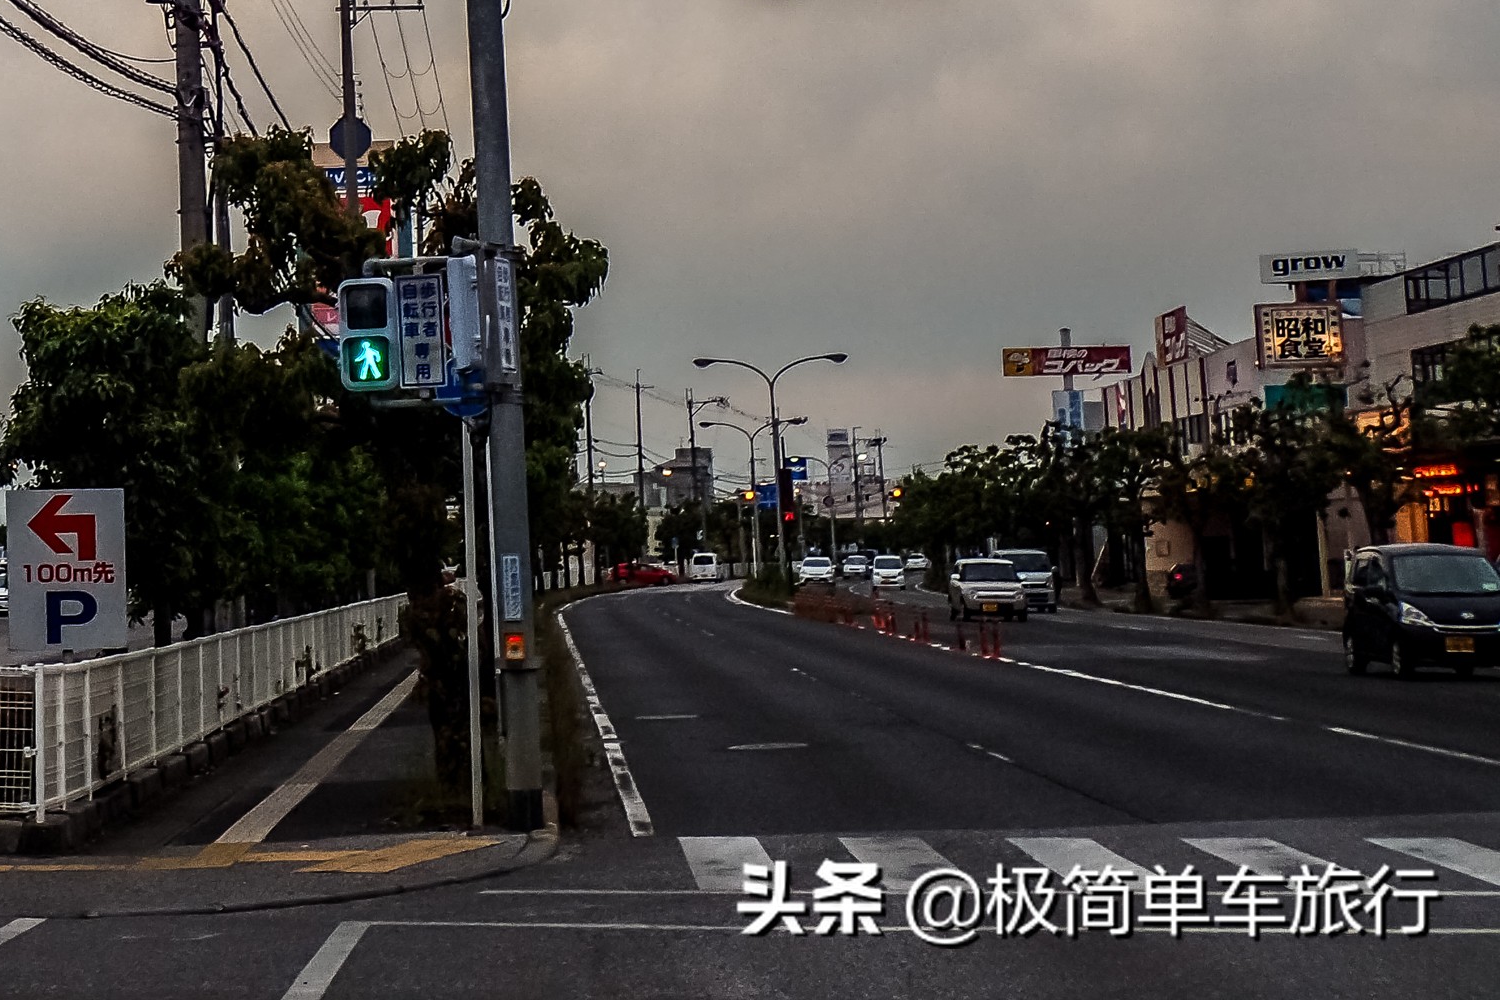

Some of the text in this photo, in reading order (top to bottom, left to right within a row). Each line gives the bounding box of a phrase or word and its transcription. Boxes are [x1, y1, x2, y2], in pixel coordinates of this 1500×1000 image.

[1271, 254, 1346, 277] grow
[1274, 316, 1326, 341] 昭和
[1277, 338, 1328, 359] 食堂
[1043, 358, 1128, 374] コバック
[23, 562, 115, 584] 100m先
[46, 590, 98, 644] P
